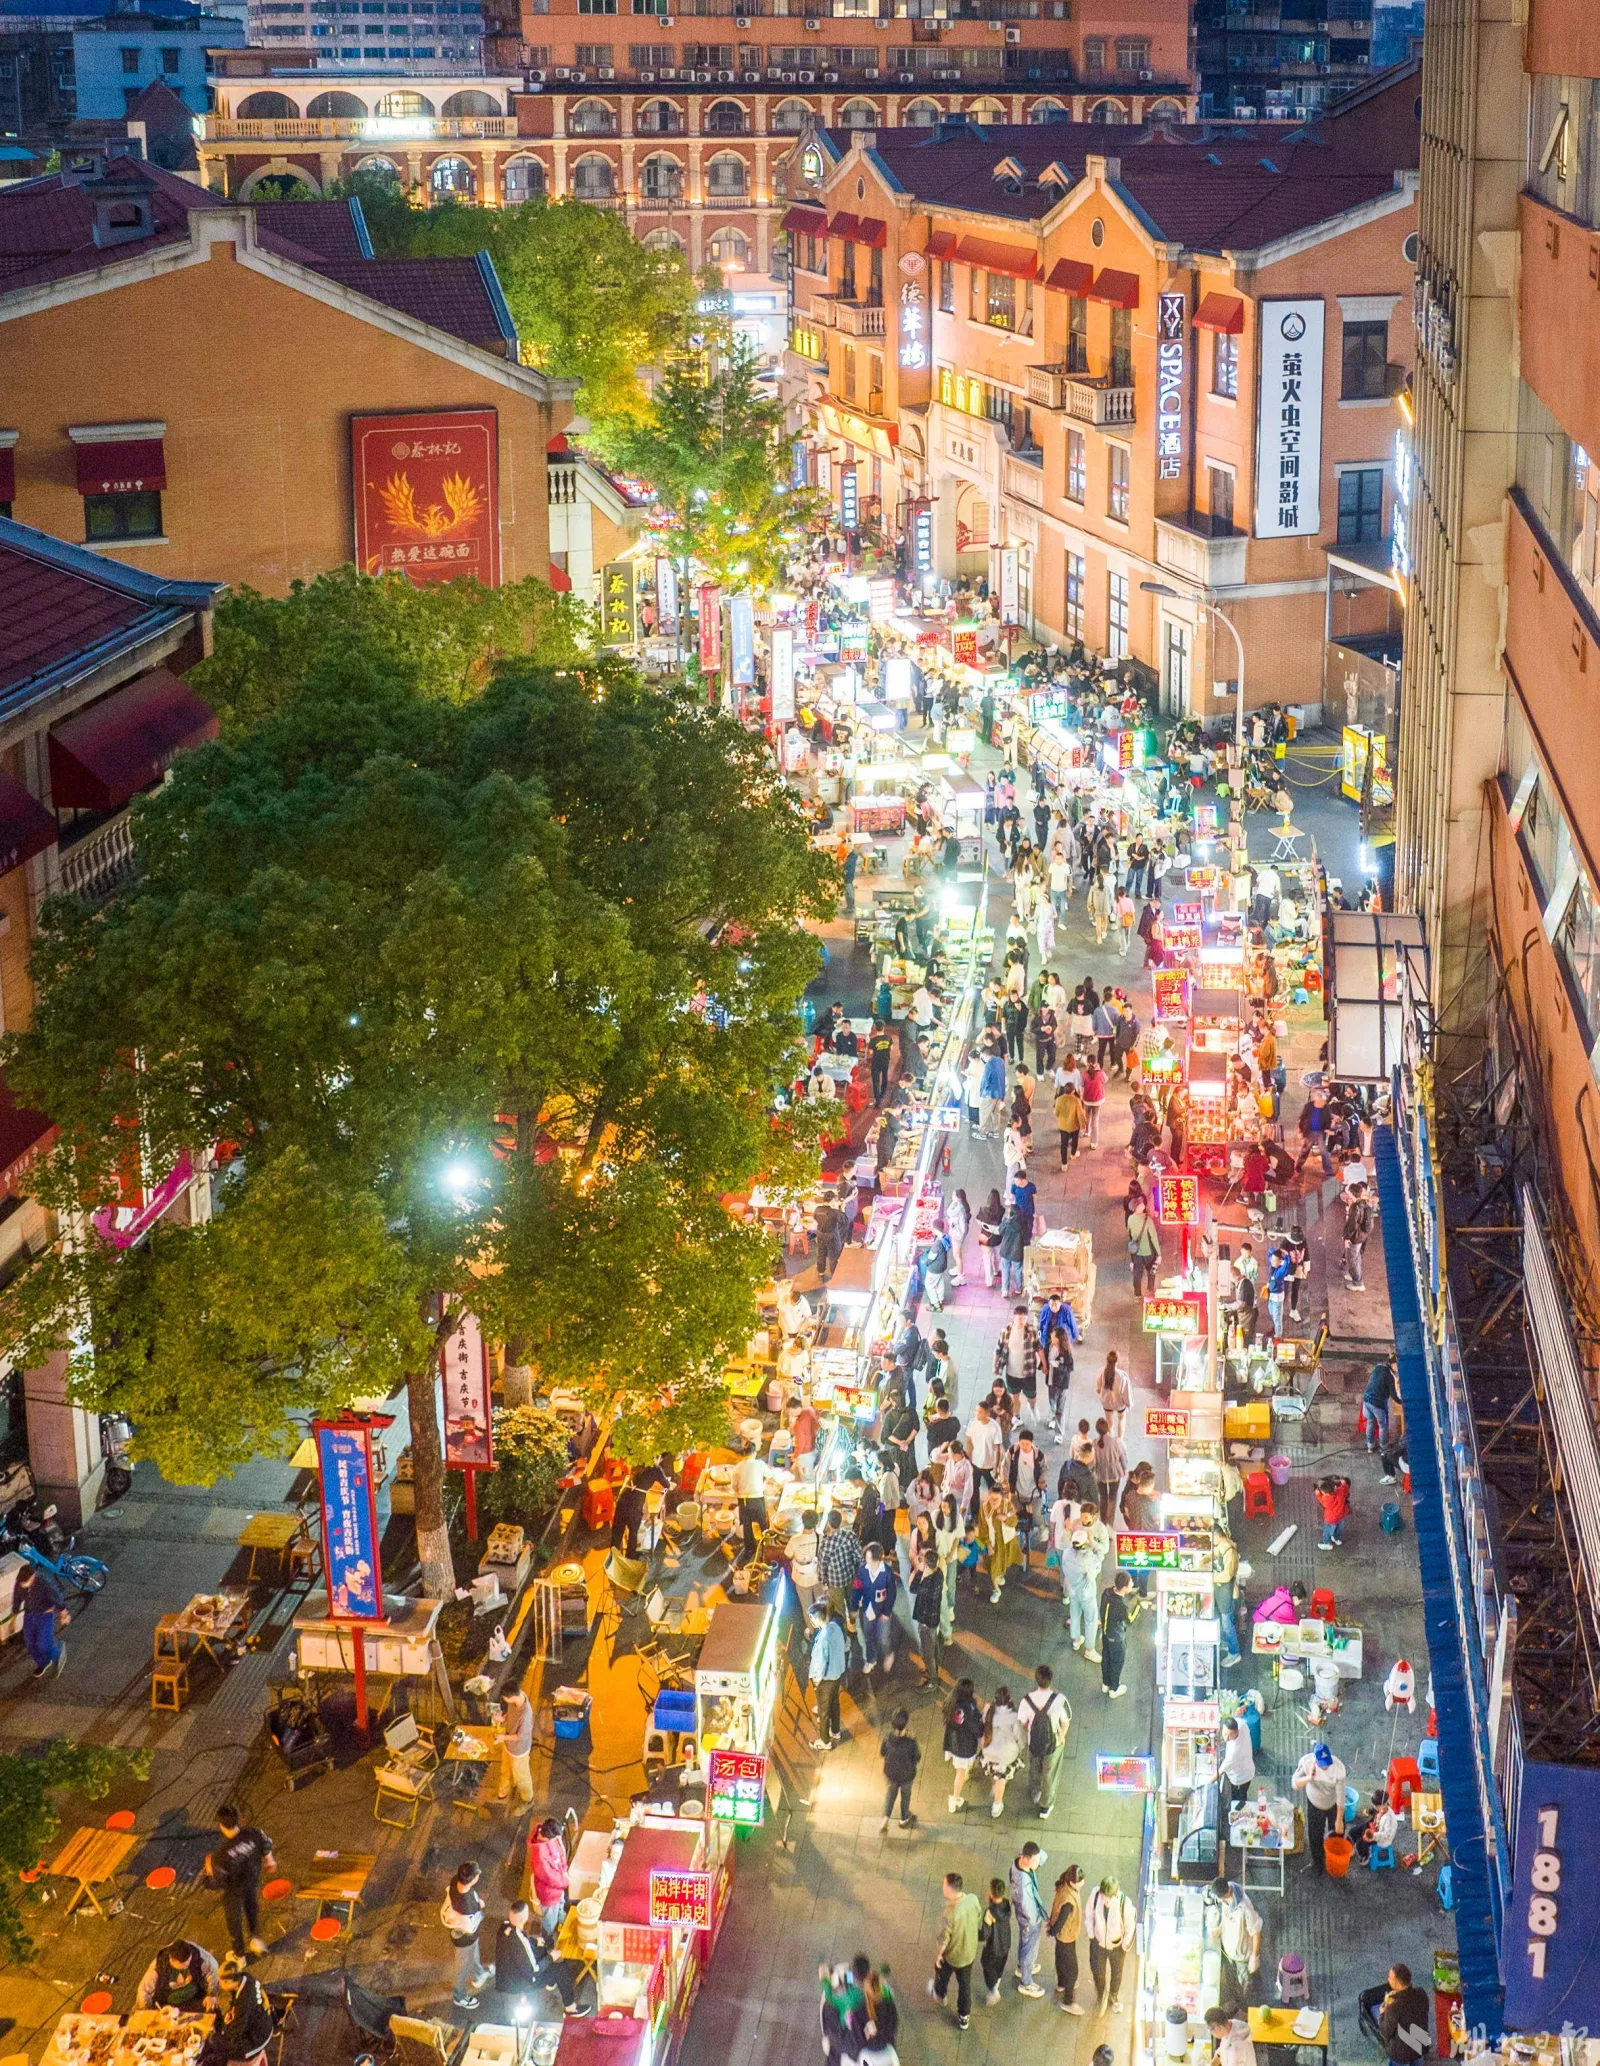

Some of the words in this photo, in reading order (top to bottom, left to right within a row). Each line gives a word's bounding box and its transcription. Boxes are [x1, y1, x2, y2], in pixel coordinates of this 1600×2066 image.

[1277, 352, 1303, 529] 萤火虫空间影城
[390, 543, 471, 563] 热爱这碗面
[1163, 1179, 1178, 1221] 东北特色
[1180, 1179, 1195, 1221] 铁板鱿鱼
[456, 1324, 470, 1364] 吉庆街
[458, 1368, 472, 1408] 吉庆节
[1119, 1551, 1177, 1567] 一元一只
[1120, 1536, 1178, 1553] 蒜香生蚝
[715, 1756, 760, 1779] 汤包
[656, 1879, 706, 1900] 凉拌牛肉
[1528, 1805, 1562, 1980] 1881
[655, 1901, 706, 1923] 拌面凉皮
